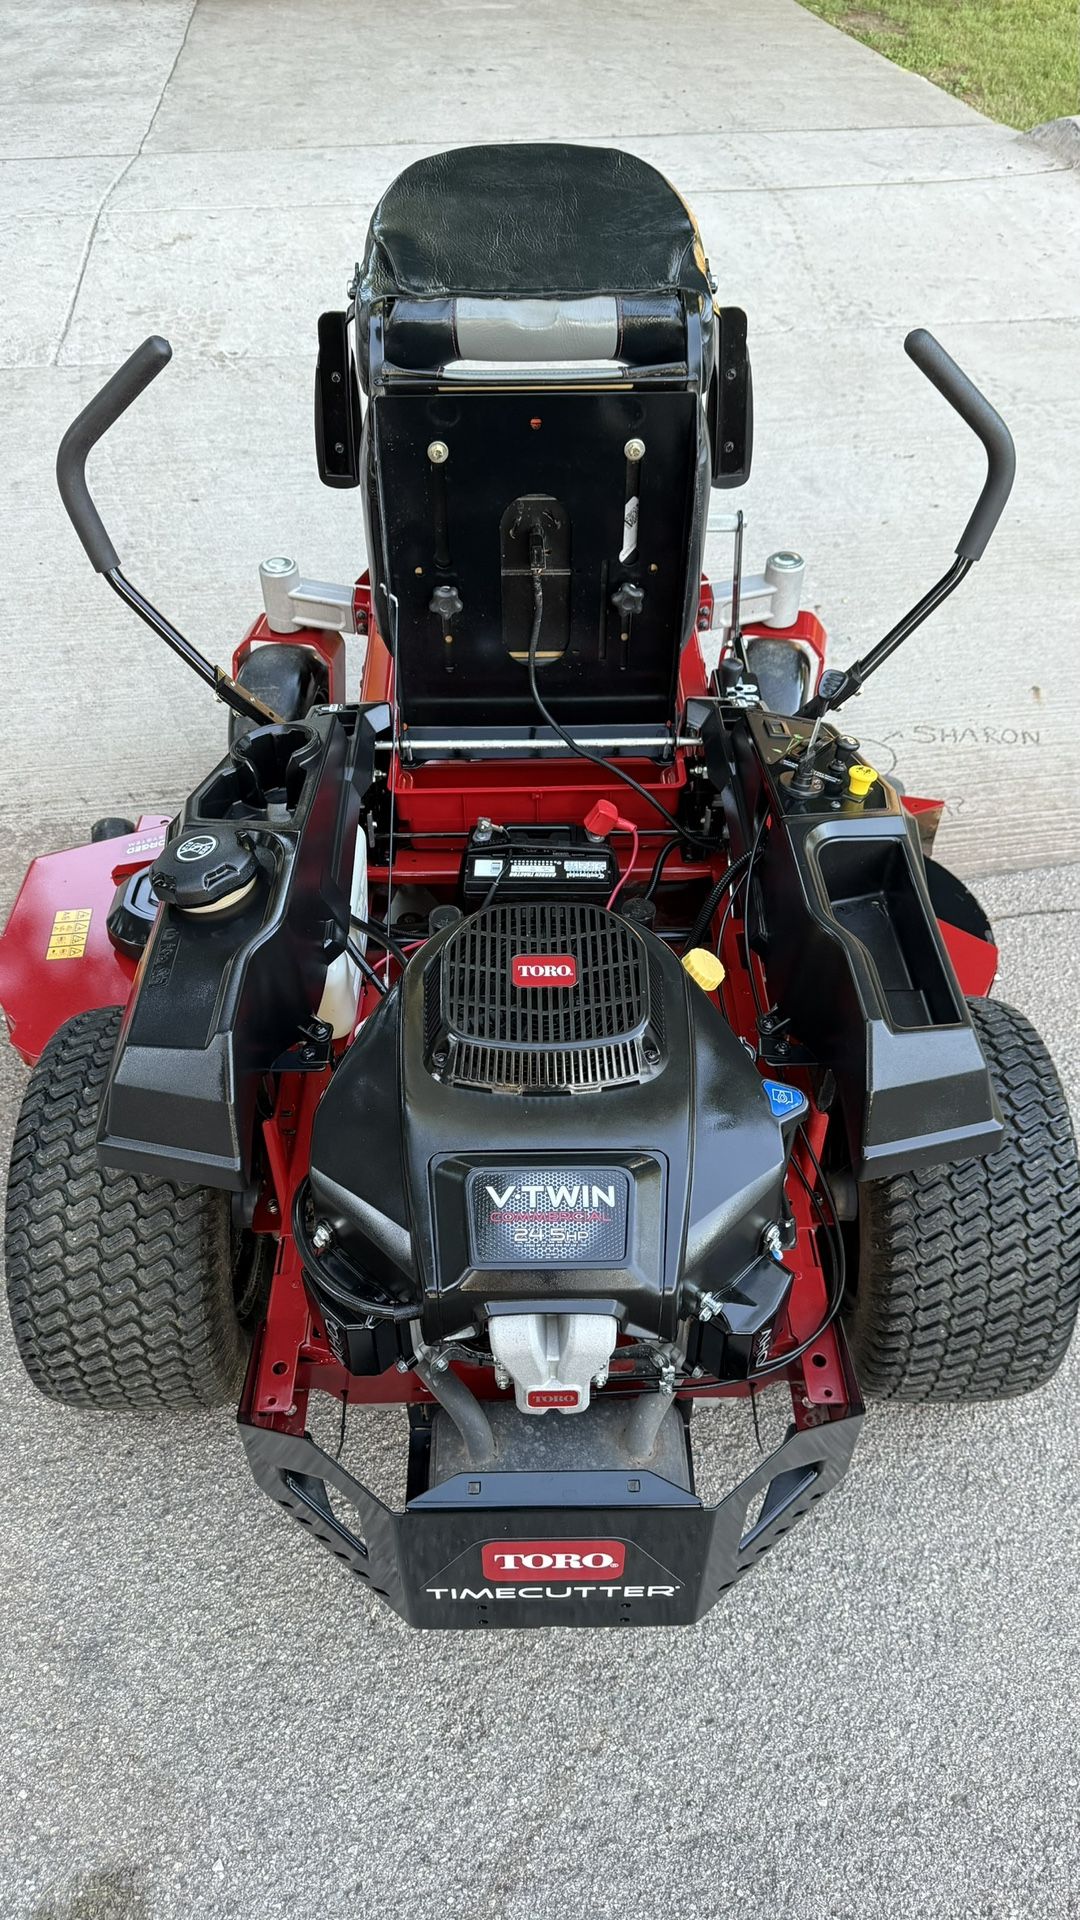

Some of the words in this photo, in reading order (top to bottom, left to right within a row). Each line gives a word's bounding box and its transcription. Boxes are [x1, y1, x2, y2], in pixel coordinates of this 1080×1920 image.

[913, 725, 1040, 745] SHARON
[517, 965, 574, 977] TORO
[490, 1211, 612, 1223] COMMERCIAL
[755, 1328, 772, 1367] OHV
[532, 1394, 577, 1403] TORO
[426, 1585, 680, 1599] TIMECUTTER
